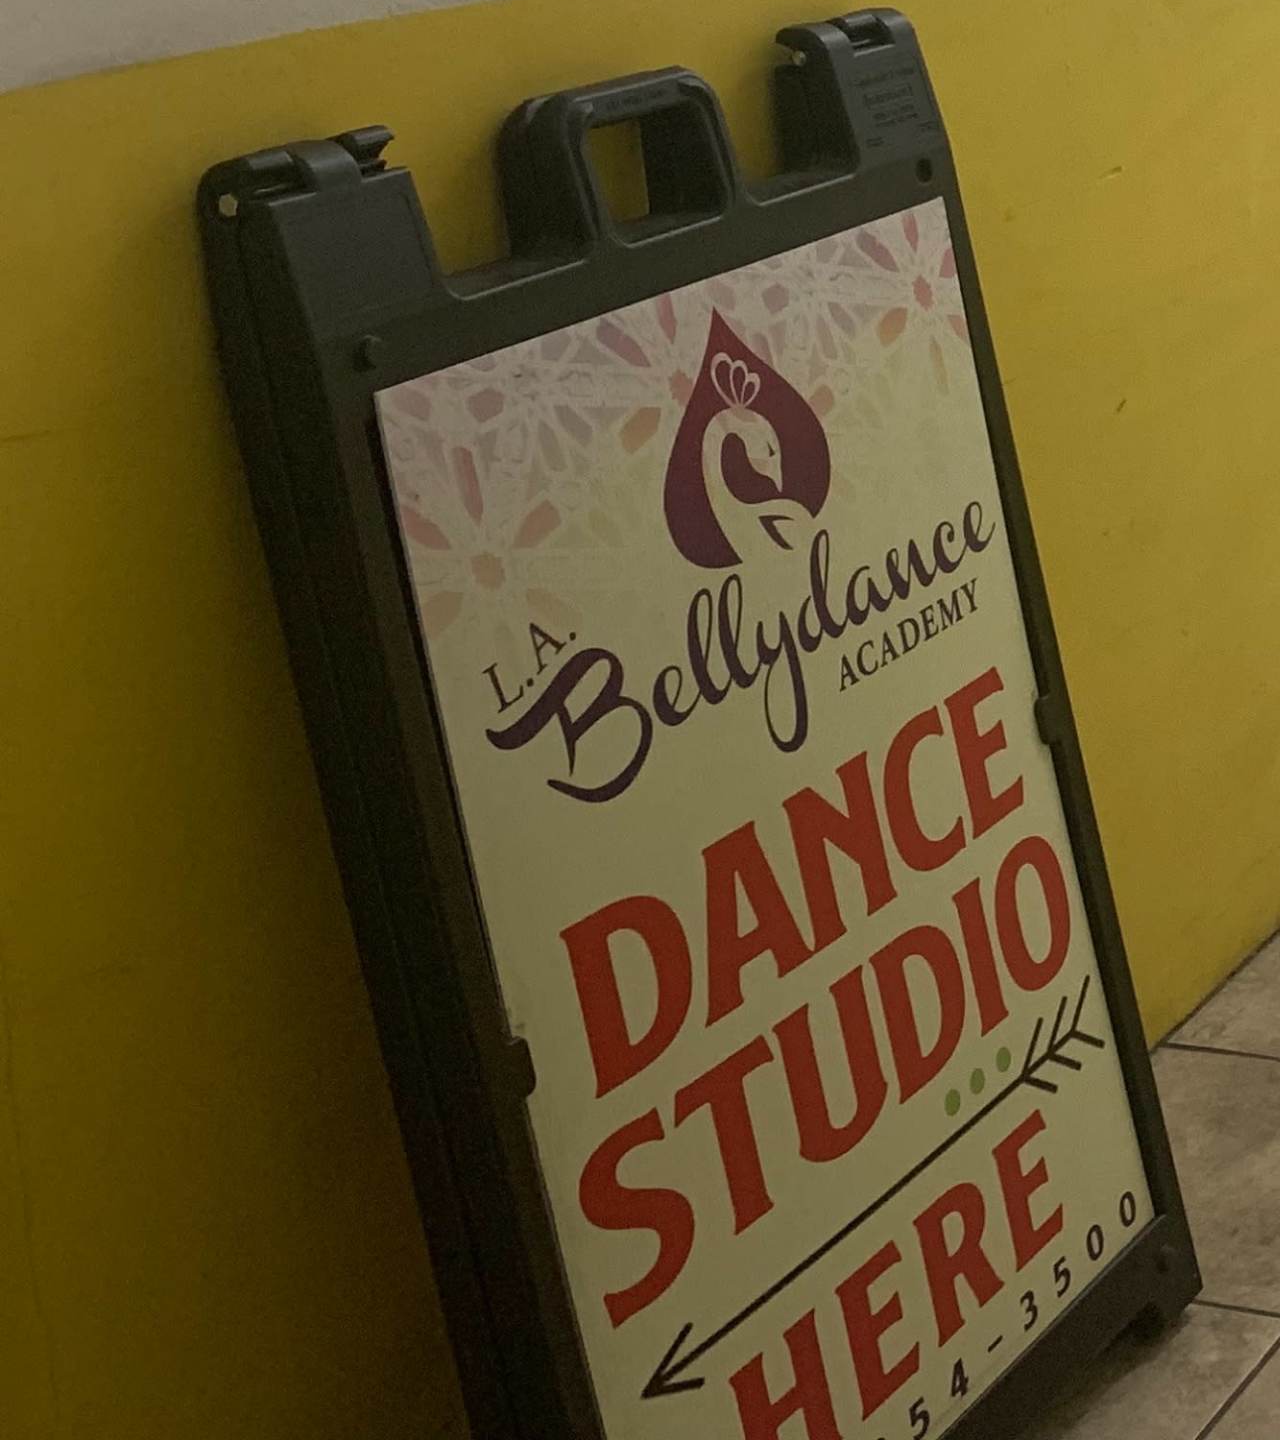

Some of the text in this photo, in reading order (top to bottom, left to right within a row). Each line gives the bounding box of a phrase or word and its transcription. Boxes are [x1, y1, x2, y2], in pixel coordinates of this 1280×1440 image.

[483, 620, 578, 711] L.A.
[484, 500, 996, 803] Bellydance
[837, 577, 981, 692] ACADEMY
[560, 666, 1025, 1099] DANCE
[577, 835, 1072, 1330] STUDIO
[728, 1109, 1065, 1440] HERE
[875, 1190, 1137, 1440] 54-3500
